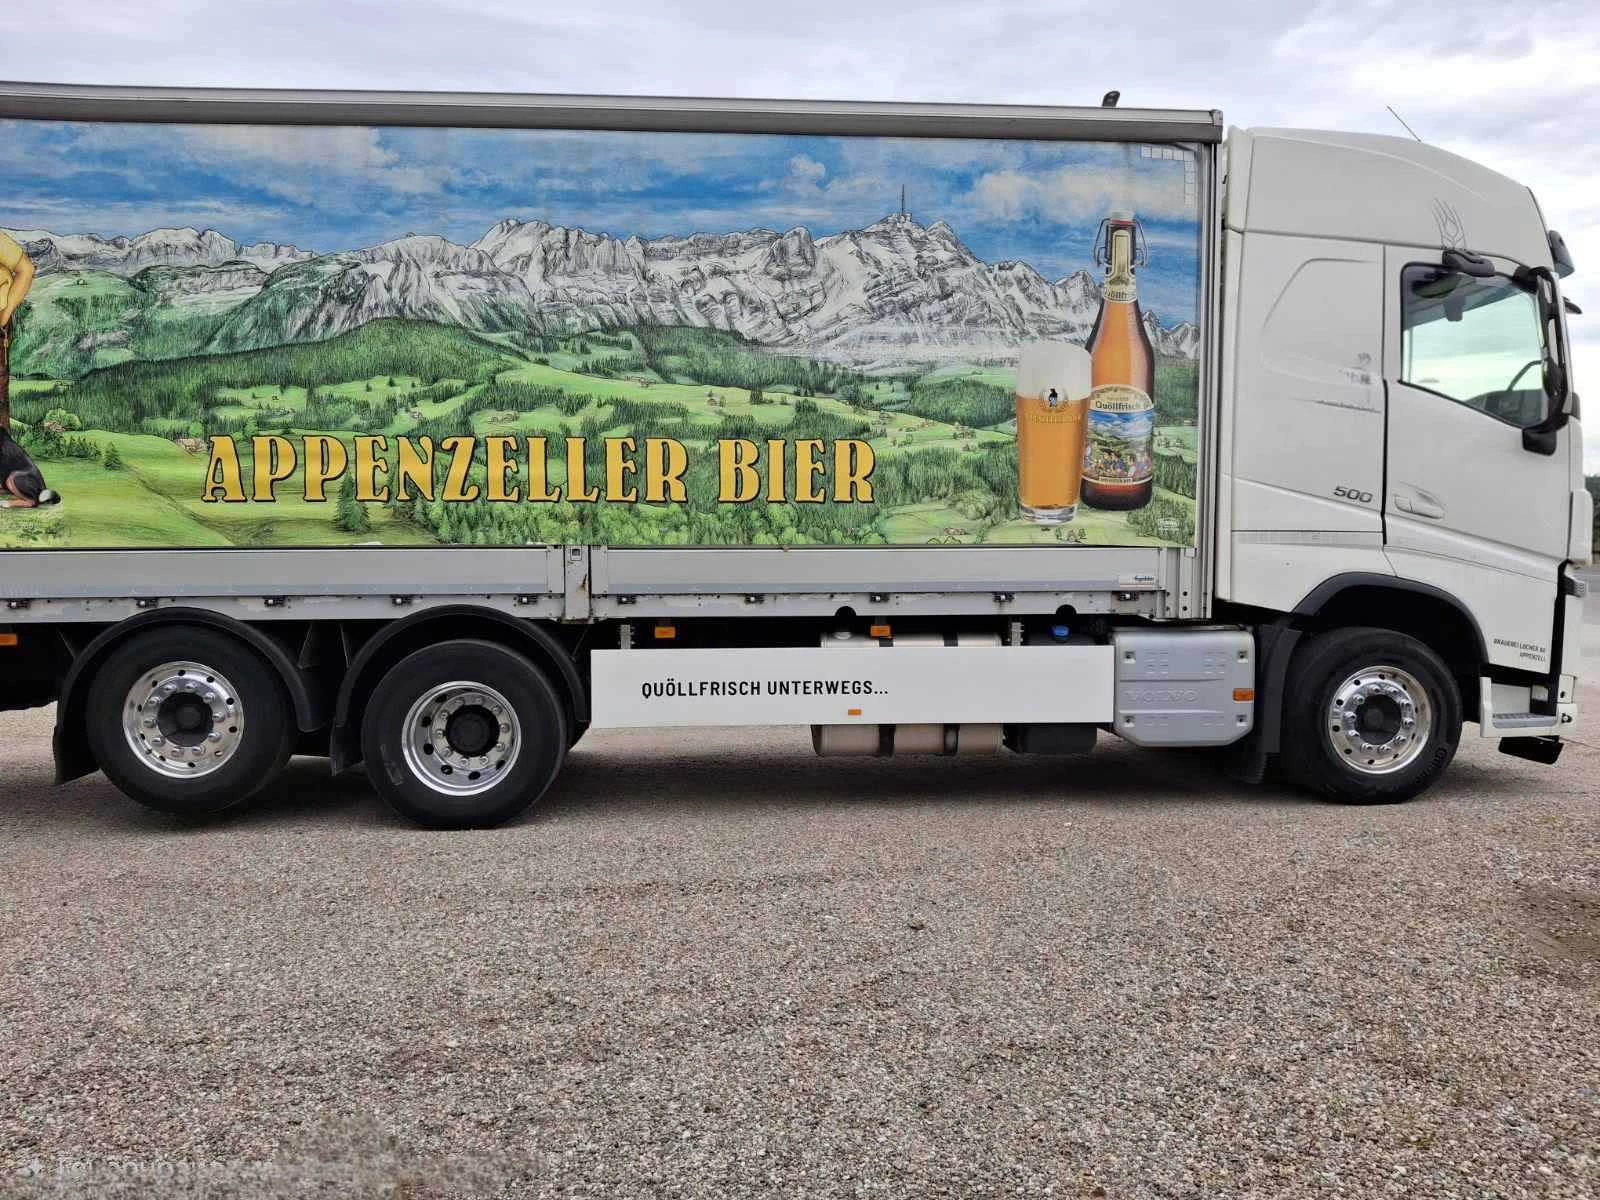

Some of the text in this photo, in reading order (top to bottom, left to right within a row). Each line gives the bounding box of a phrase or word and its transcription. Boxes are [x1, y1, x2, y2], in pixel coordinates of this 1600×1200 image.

[202, 434, 876, 503] APPENZELLER BIER
[1334, 486, 1373, 503] 500
[641, 678, 889, 699] QUÖLLFRISCH UNTERWEGS...
